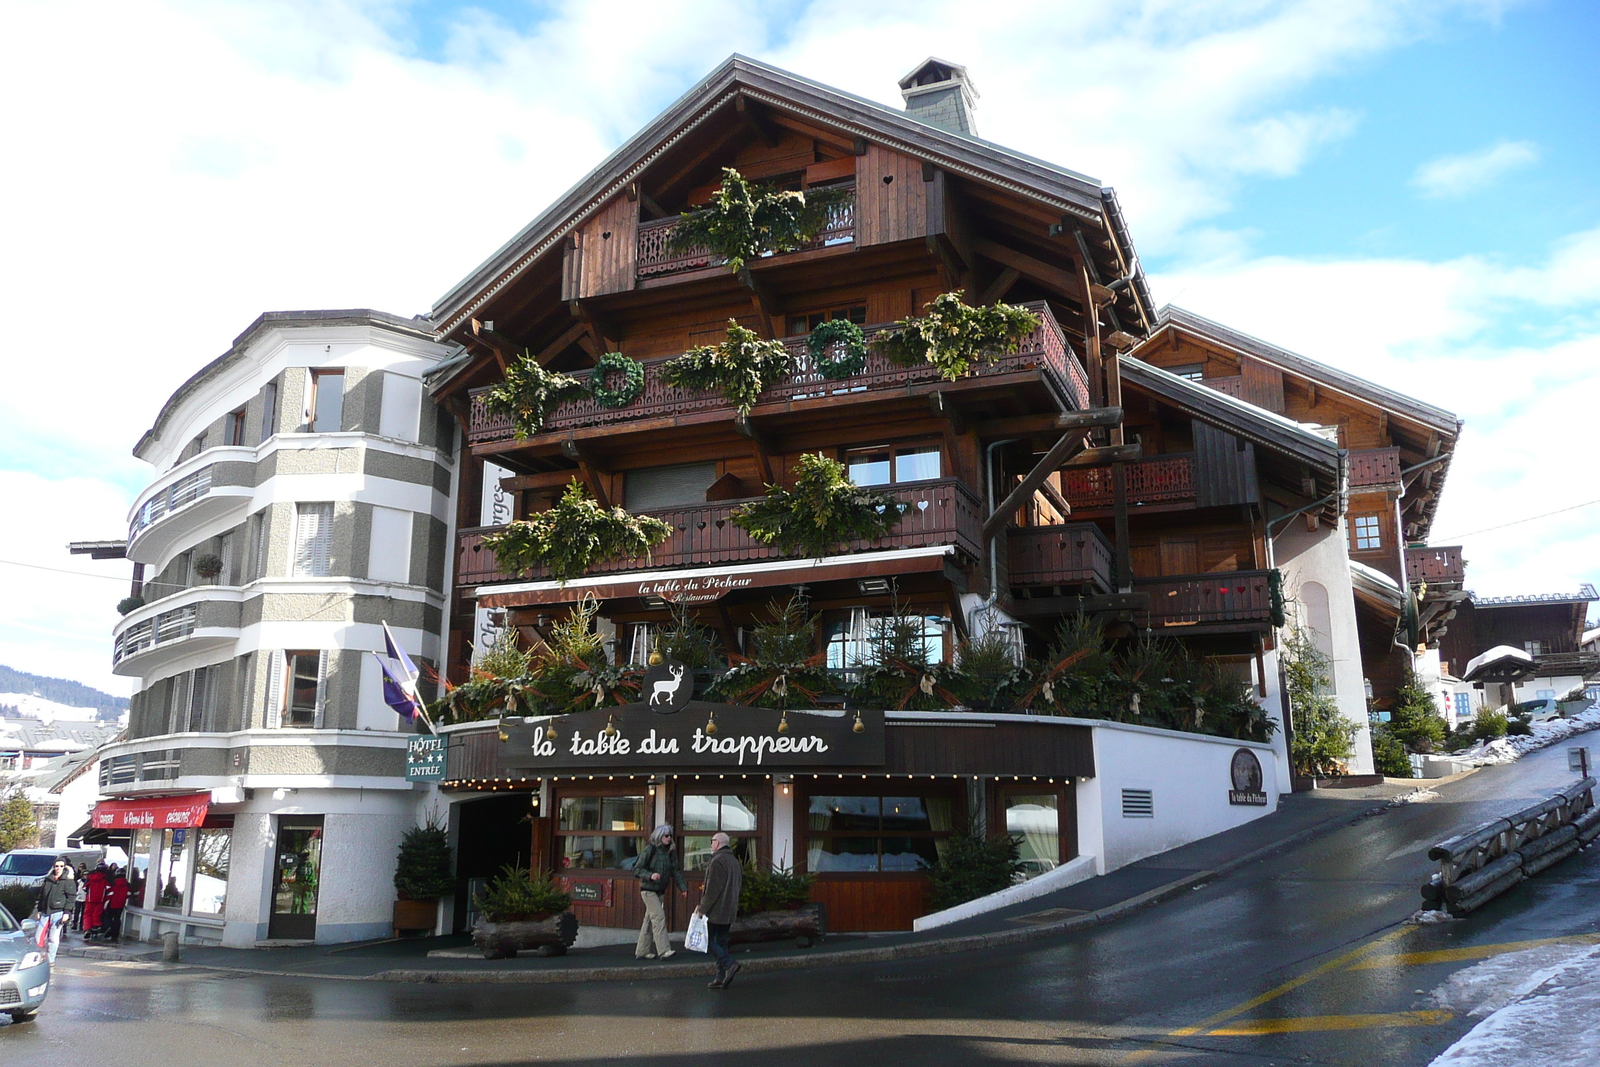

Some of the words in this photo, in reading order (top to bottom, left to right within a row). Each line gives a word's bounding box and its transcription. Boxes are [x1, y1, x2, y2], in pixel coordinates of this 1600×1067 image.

[638, 581, 650, 594] la
[653, 579, 681, 593] table
[683, 578, 699, 592] du
[702, 574, 752, 590] Pêcheur
[408, 737, 444, 753] HÔTEL
[531, 726, 556, 756] la
[569, 729, 630, 756] table
[636, 729, 680, 754] du
[691, 728, 829, 765] trappeur
[410, 763, 441, 777] ENTRÉE
